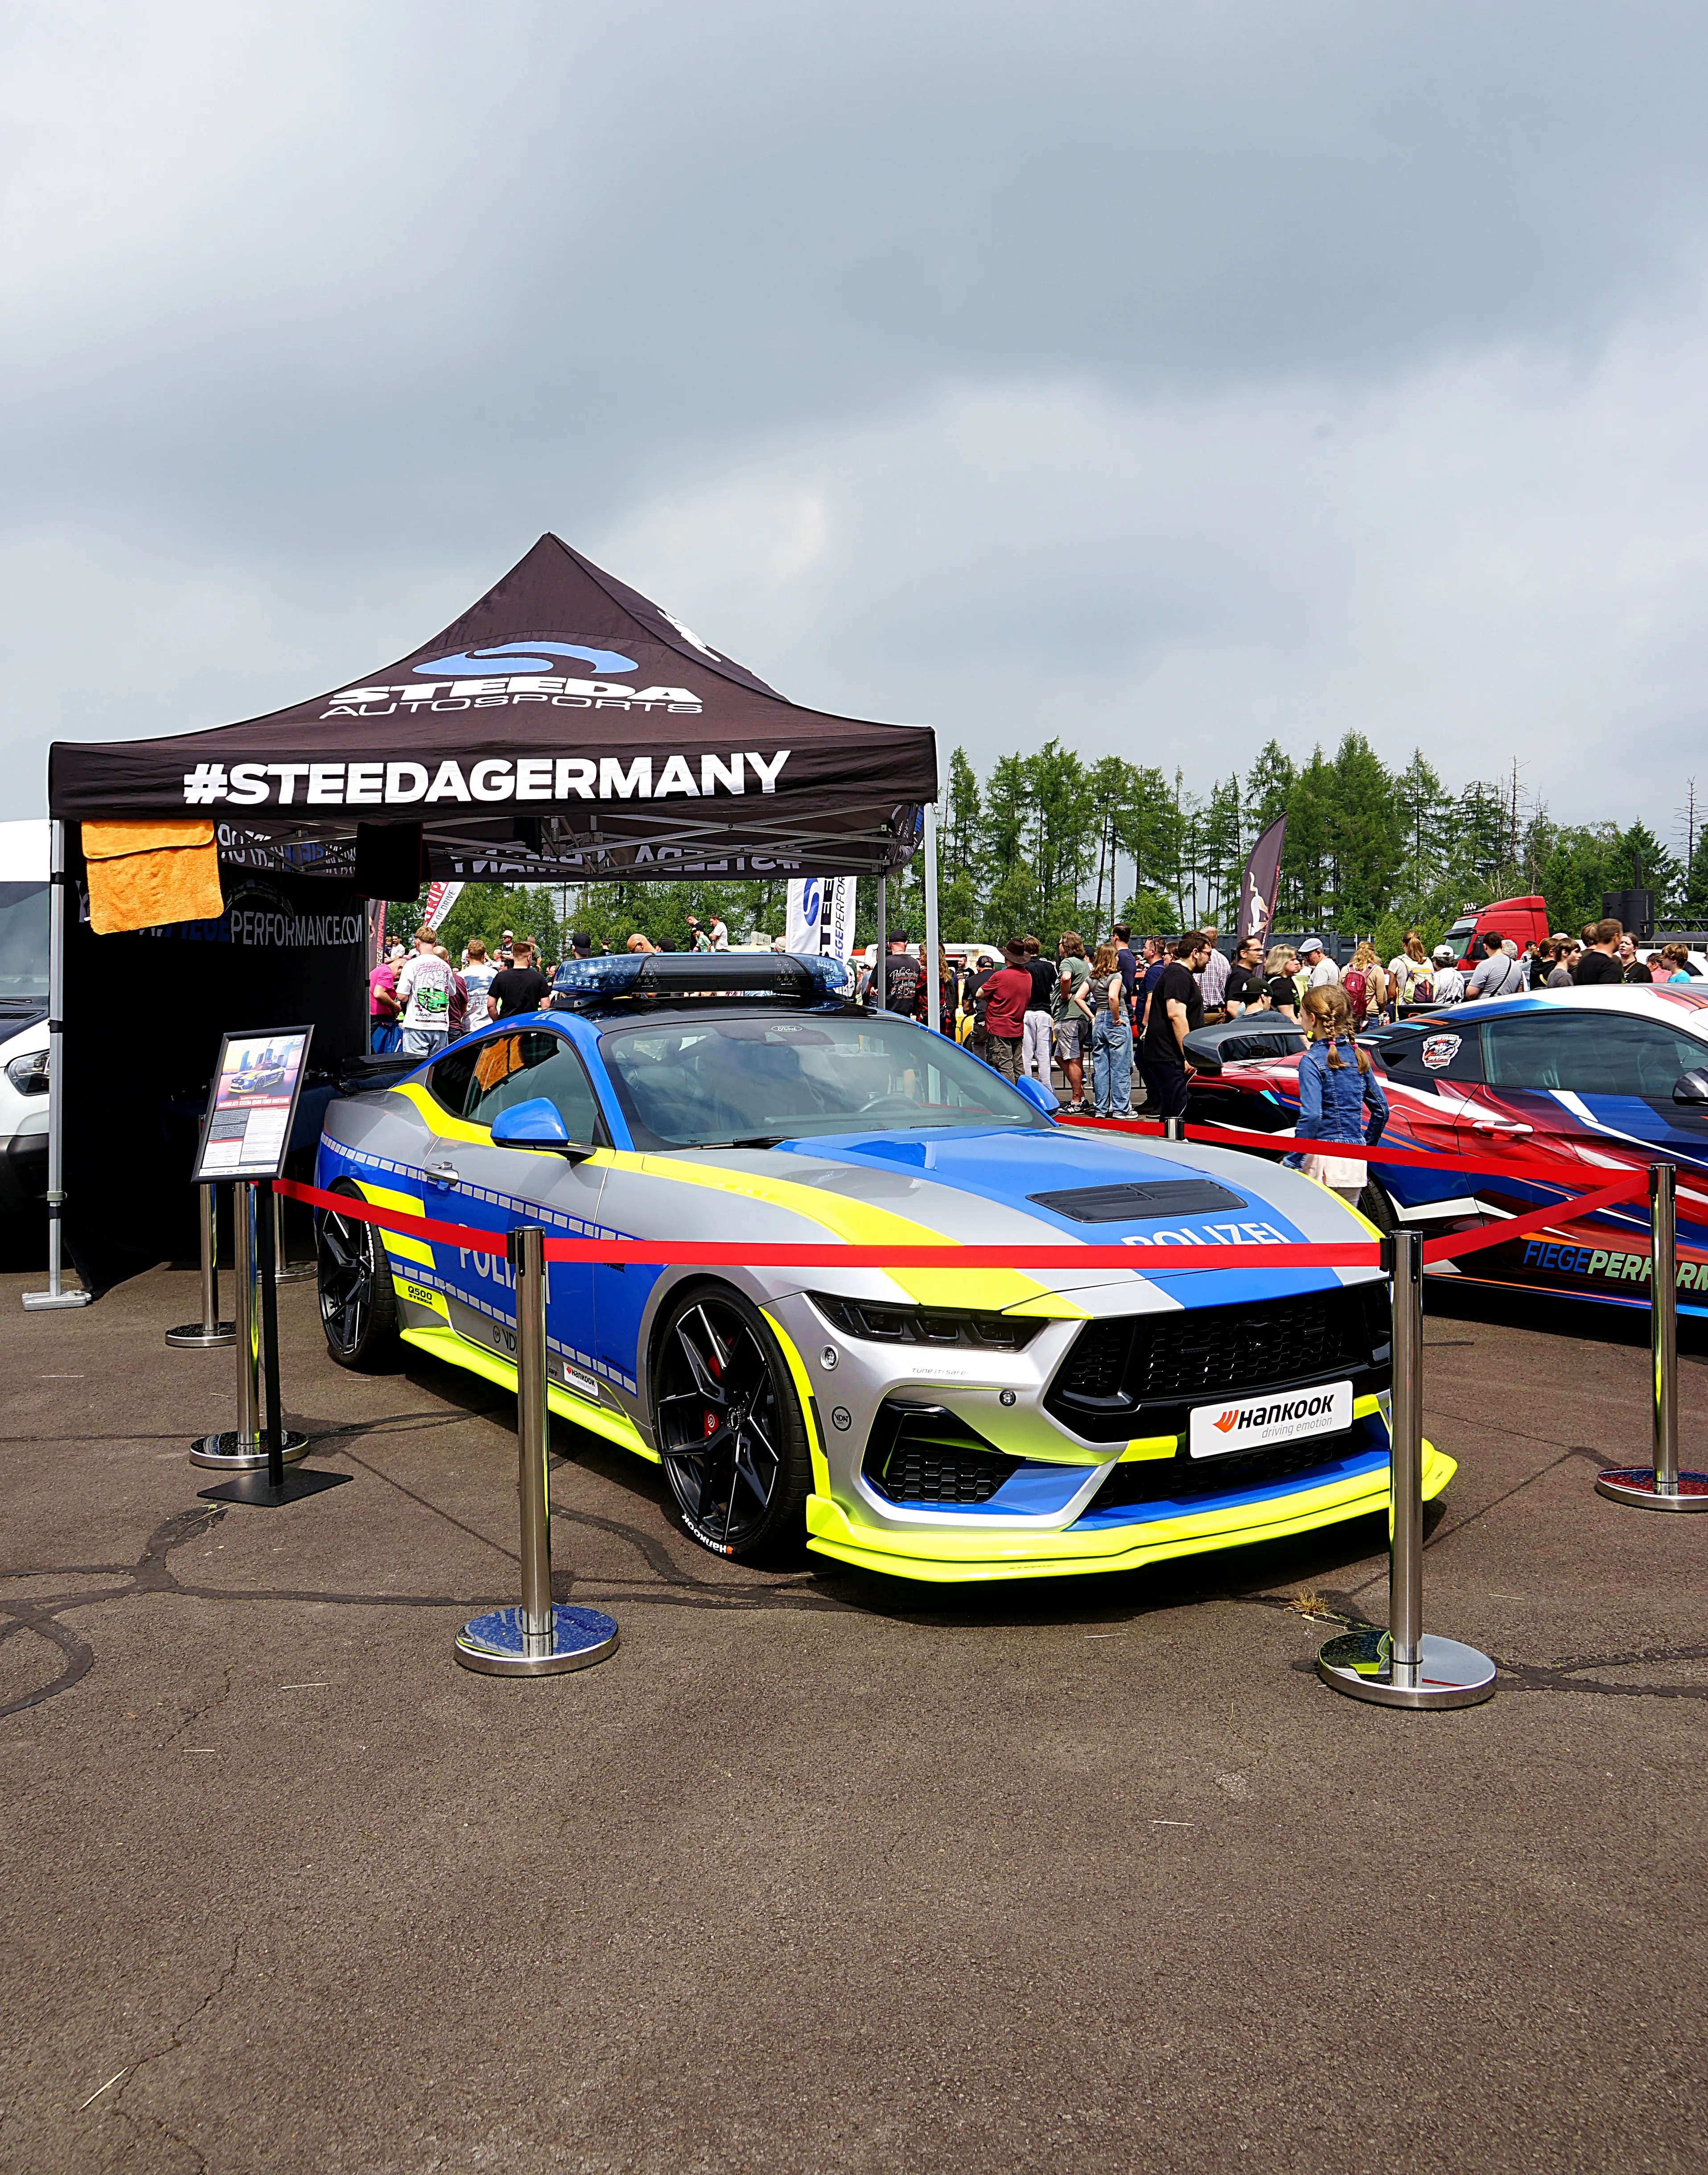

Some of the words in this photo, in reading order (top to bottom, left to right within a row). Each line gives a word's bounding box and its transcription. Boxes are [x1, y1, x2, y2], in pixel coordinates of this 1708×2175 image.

[329, 677, 703, 704] STEEDA
[319, 694, 703, 719] AUTOSPORTS
[184, 750, 792, 804] #STEEDAGERMANY
[436, 911, 443, 920] OF
[441, 889, 456, 910] DRIVE
[1523, 1241, 1708, 1291] FIEGEPERFRM
[408, 1286, 432, 1300] Q500
[409, 1293, 433, 1306] STEEDA
[502, 1328, 517, 1353] VD
[1262, 1425, 1293, 1439] driving
[1296, 1417, 1332, 1431] emotion
